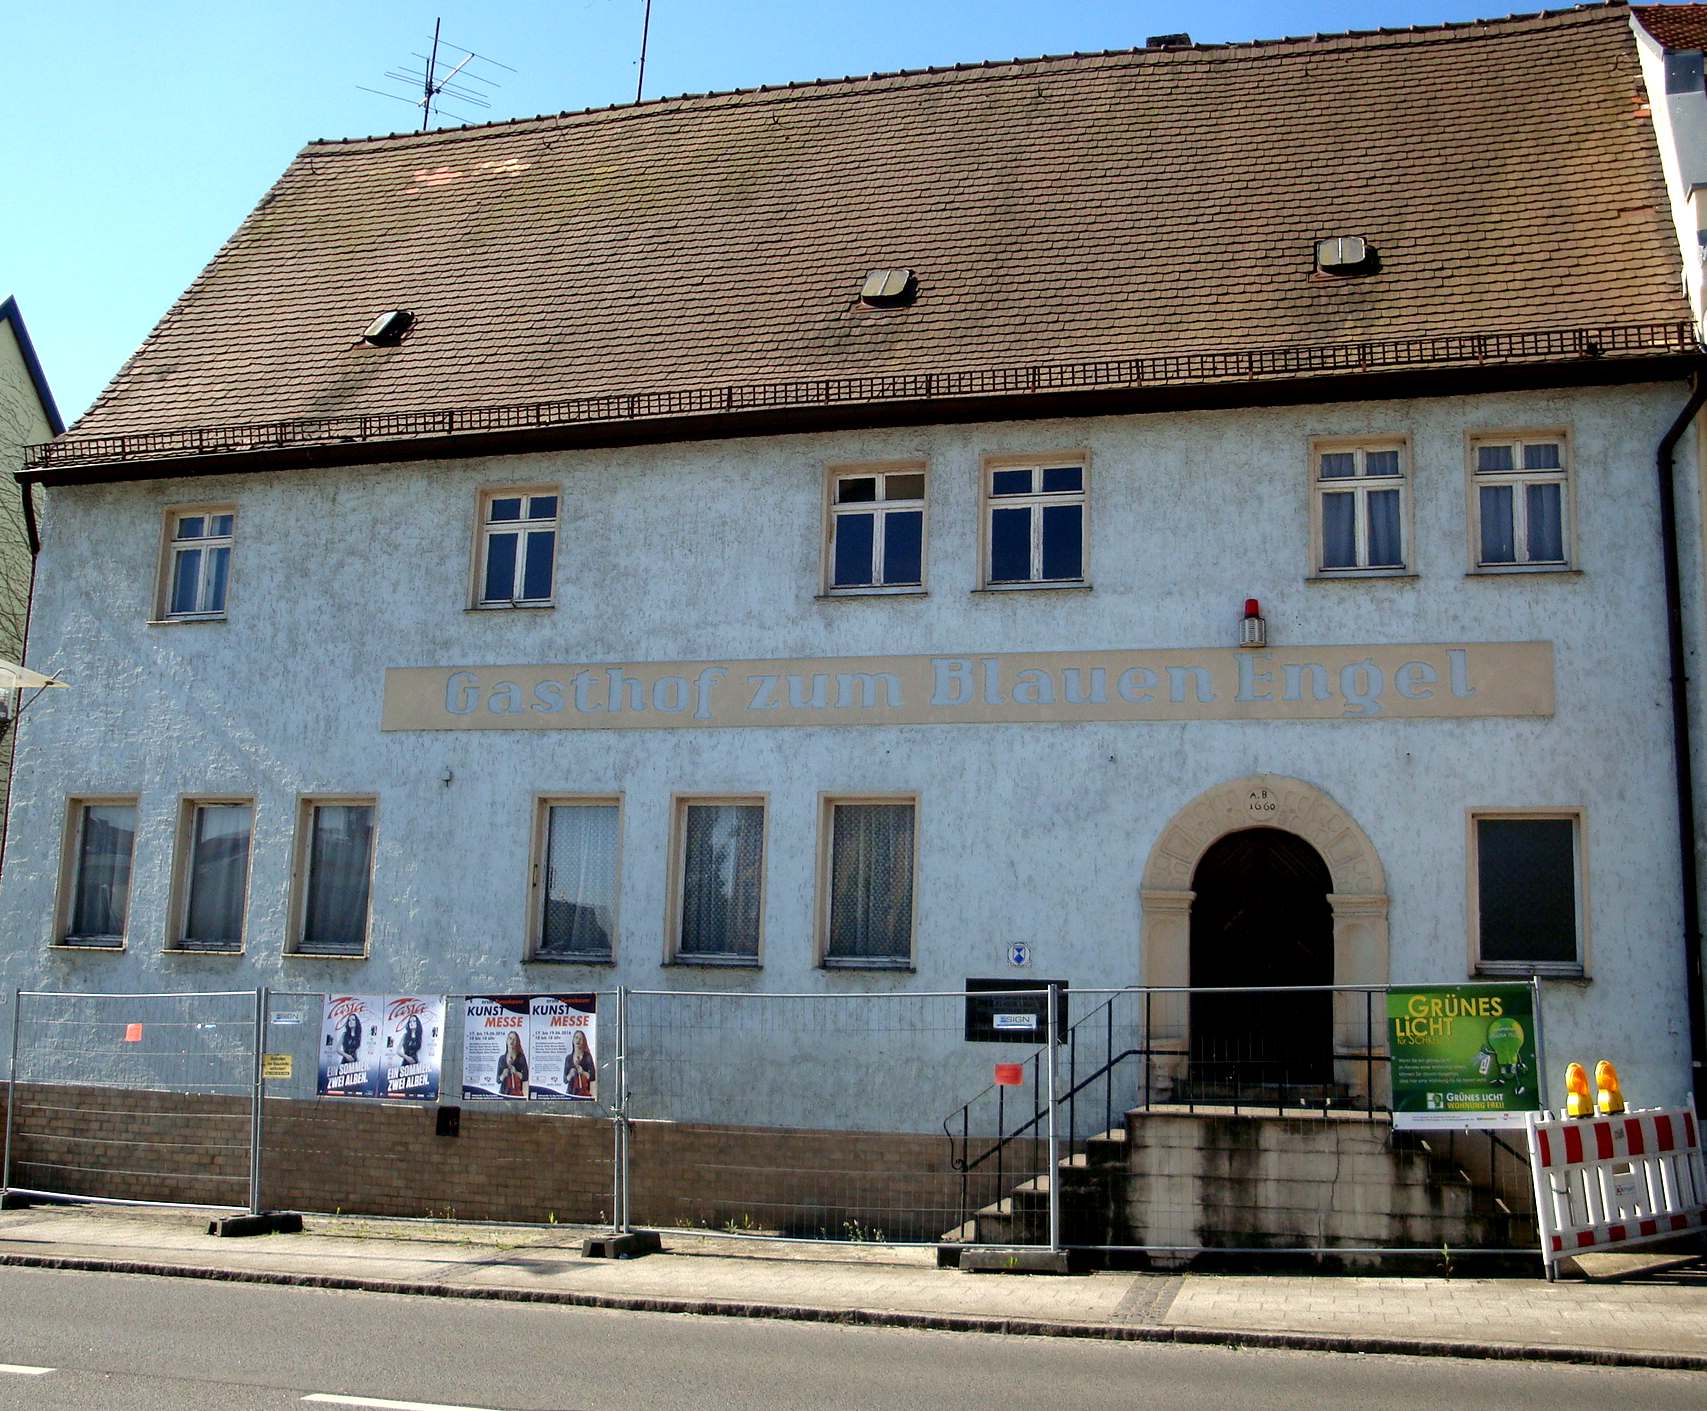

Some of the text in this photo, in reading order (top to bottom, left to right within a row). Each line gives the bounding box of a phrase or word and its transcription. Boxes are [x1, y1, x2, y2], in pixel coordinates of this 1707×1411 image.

[445, 649, 1476, 720] Gasthof zum Blauen Engel
[467, 1005, 504, 1017] KUNST
[532, 1004, 570, 1016] KUNST
[1408, 994, 1504, 1017] GRÜNES
[484, 1016, 524, 1028] MESSE
[550, 1015, 590, 1027] MESSE
